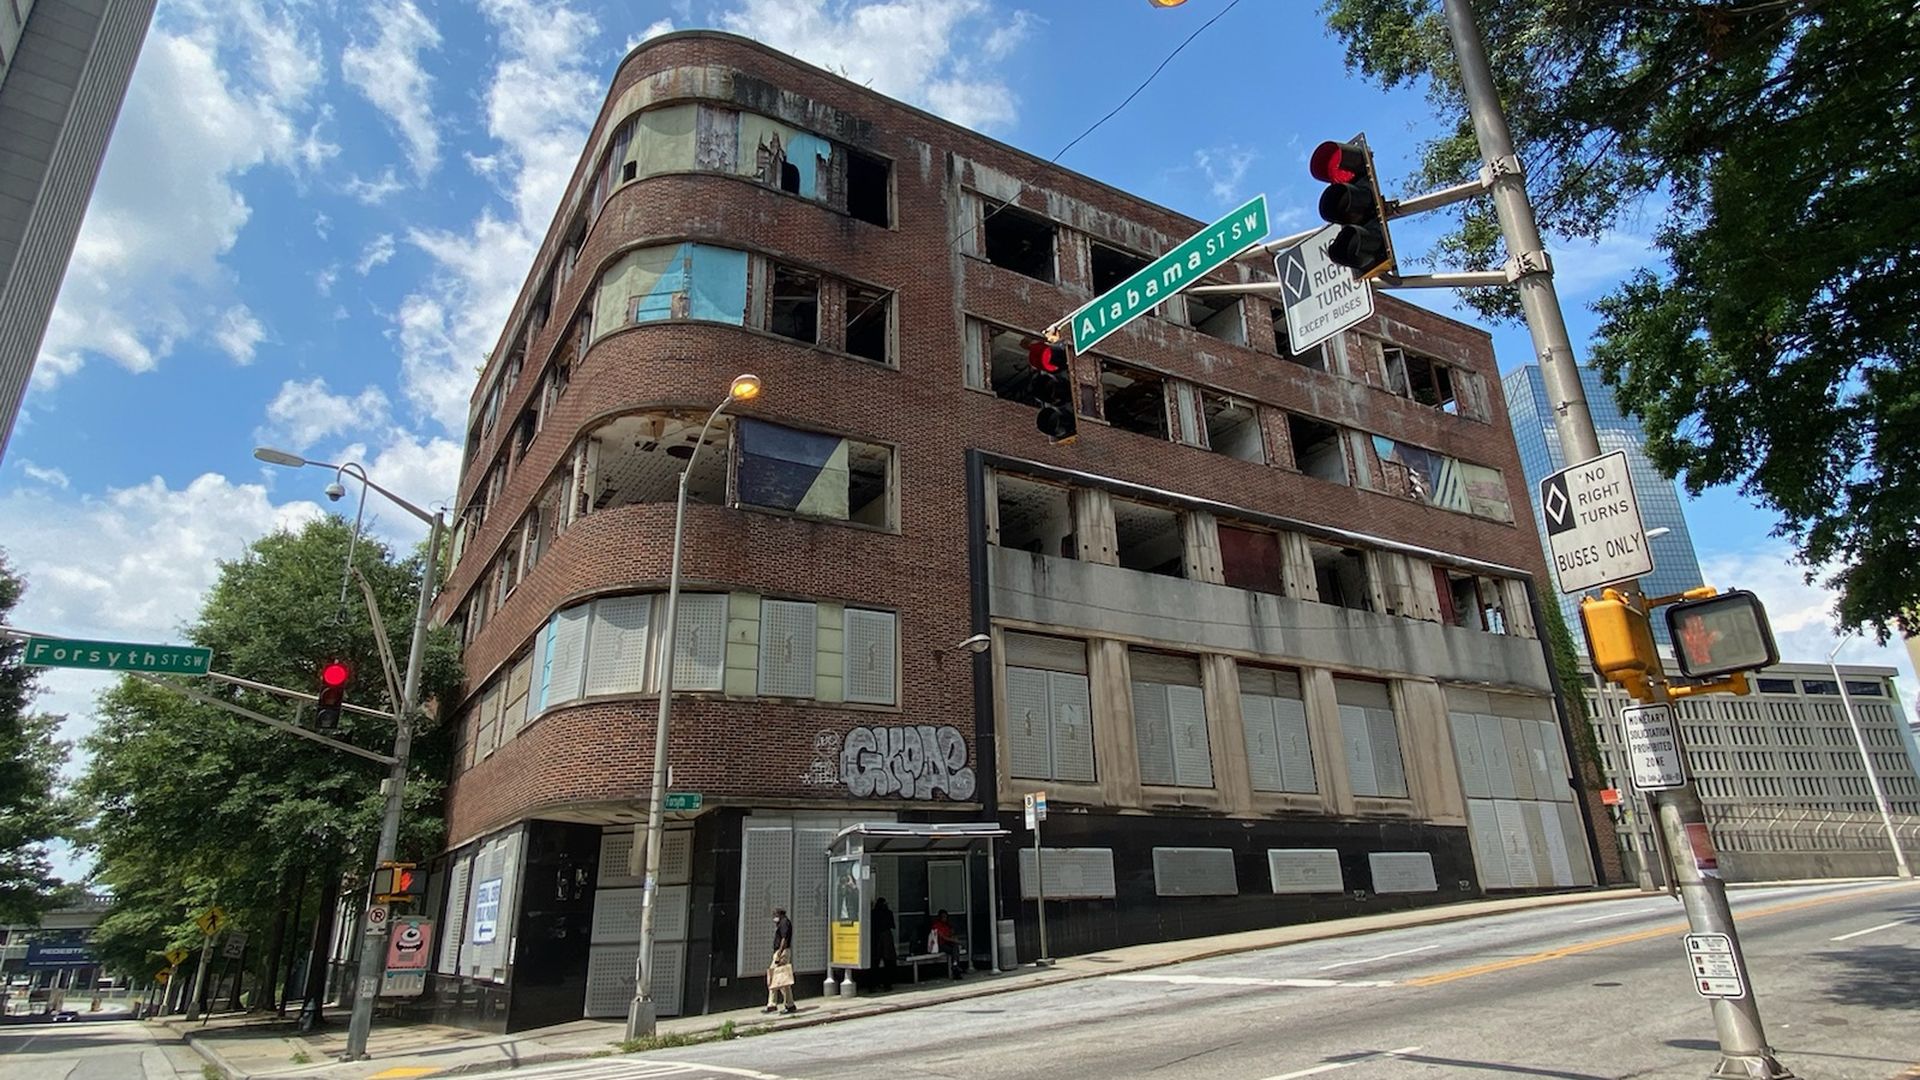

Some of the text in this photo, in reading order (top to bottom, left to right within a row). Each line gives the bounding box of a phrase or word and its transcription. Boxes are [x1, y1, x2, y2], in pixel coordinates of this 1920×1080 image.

[1080, 212, 1257, 341] Alabama ST SW
[1313, 263, 1347, 288] RIGH
[1299, 297, 1362, 337] EXCEPT BUSES
[1585, 467, 1605, 483] NO
[1578, 482, 1620, 506] RIGHT
[1580, 500, 1629, 525] TURNS
[1558, 532, 1640, 572] BUSES ONLY
[33, 644, 204, 667] Forsyth ST SW
[1628, 712, 1665, 725] MONETARY
[1630, 727, 1670, 740] SOLICITATION
[1633, 741, 1672, 754] PROHIBITED
[1646, 756, 1665, 767] ZONE
[226, 943, 241, 956] 25
